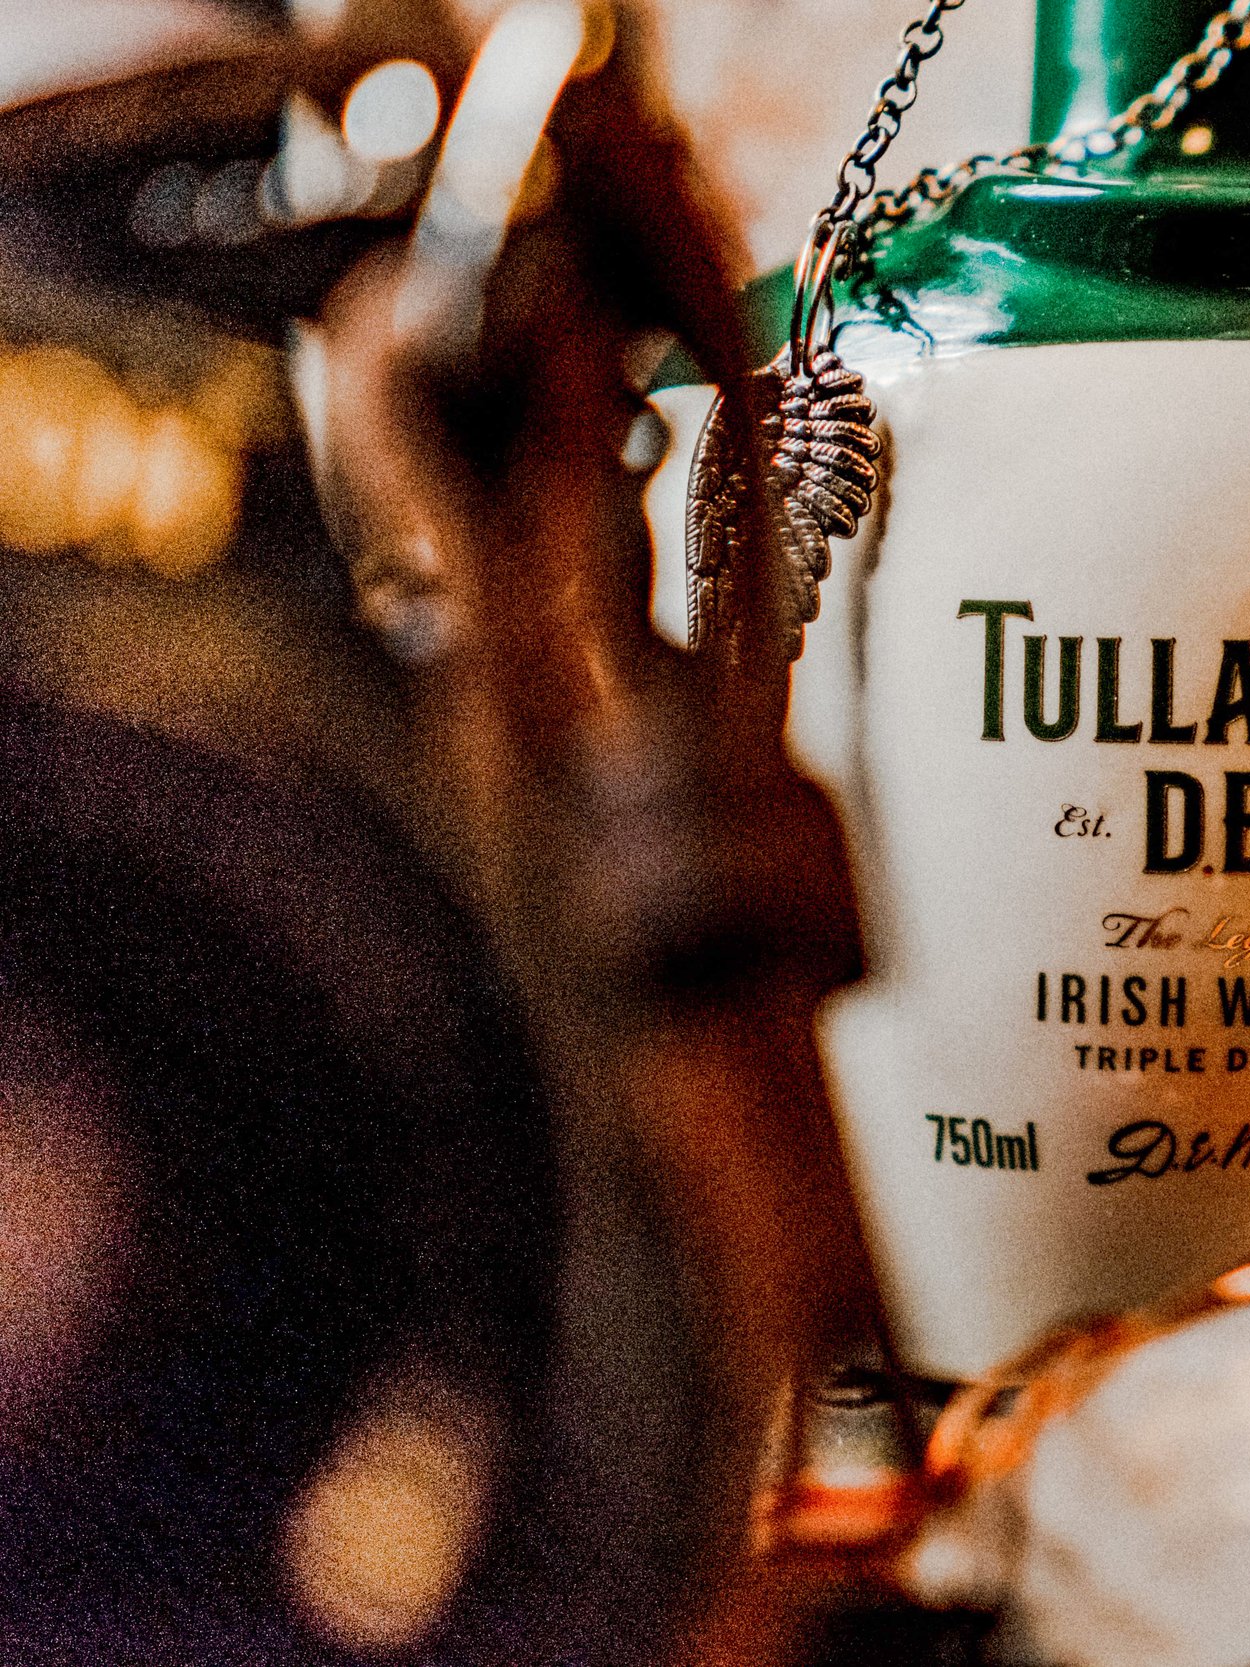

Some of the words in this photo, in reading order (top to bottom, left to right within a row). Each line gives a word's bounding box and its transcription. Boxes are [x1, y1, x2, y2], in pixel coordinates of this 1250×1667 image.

[1053, 803, 1112, 839] Est.
[1102, 907, 1189, 949] The
[1037, 971, 1188, 1027] IRISH
[1074, 1045, 1206, 1073] TRIPLE
[925, 1113, 1040, 1171] 750ml
